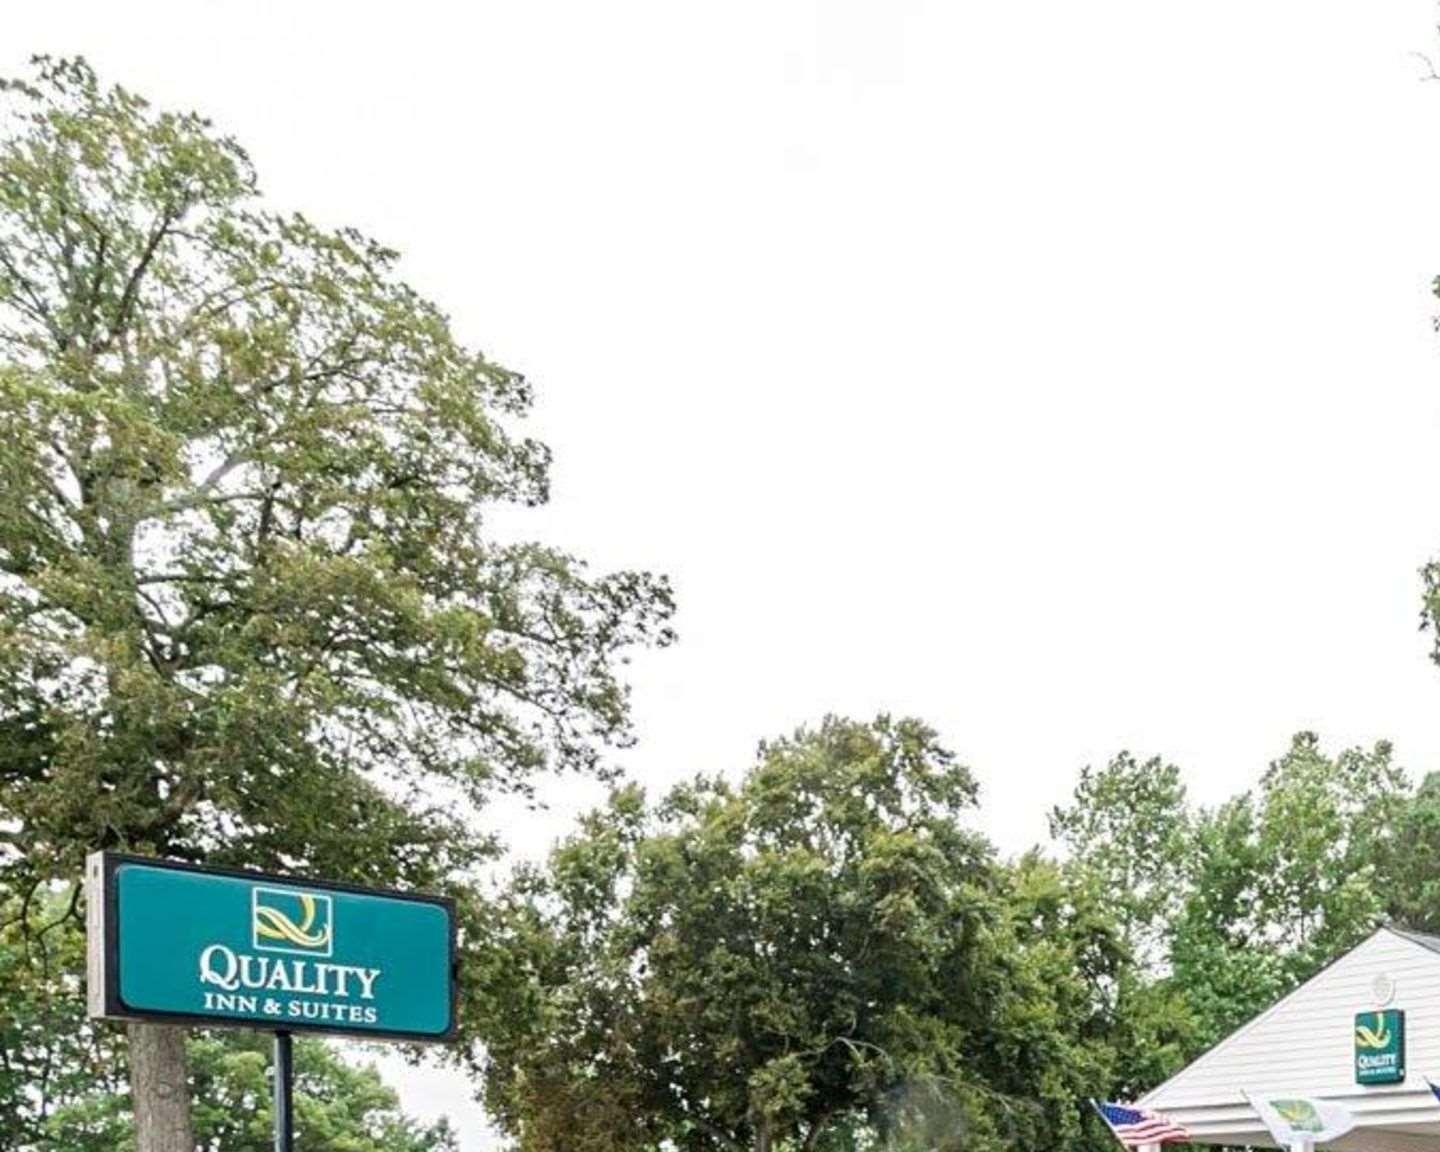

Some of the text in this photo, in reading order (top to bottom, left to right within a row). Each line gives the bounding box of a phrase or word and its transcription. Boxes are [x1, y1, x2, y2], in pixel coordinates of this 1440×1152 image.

[200, 944, 380, 999] QUALITY
[204, 992, 376, 1022] INN & SUITES
